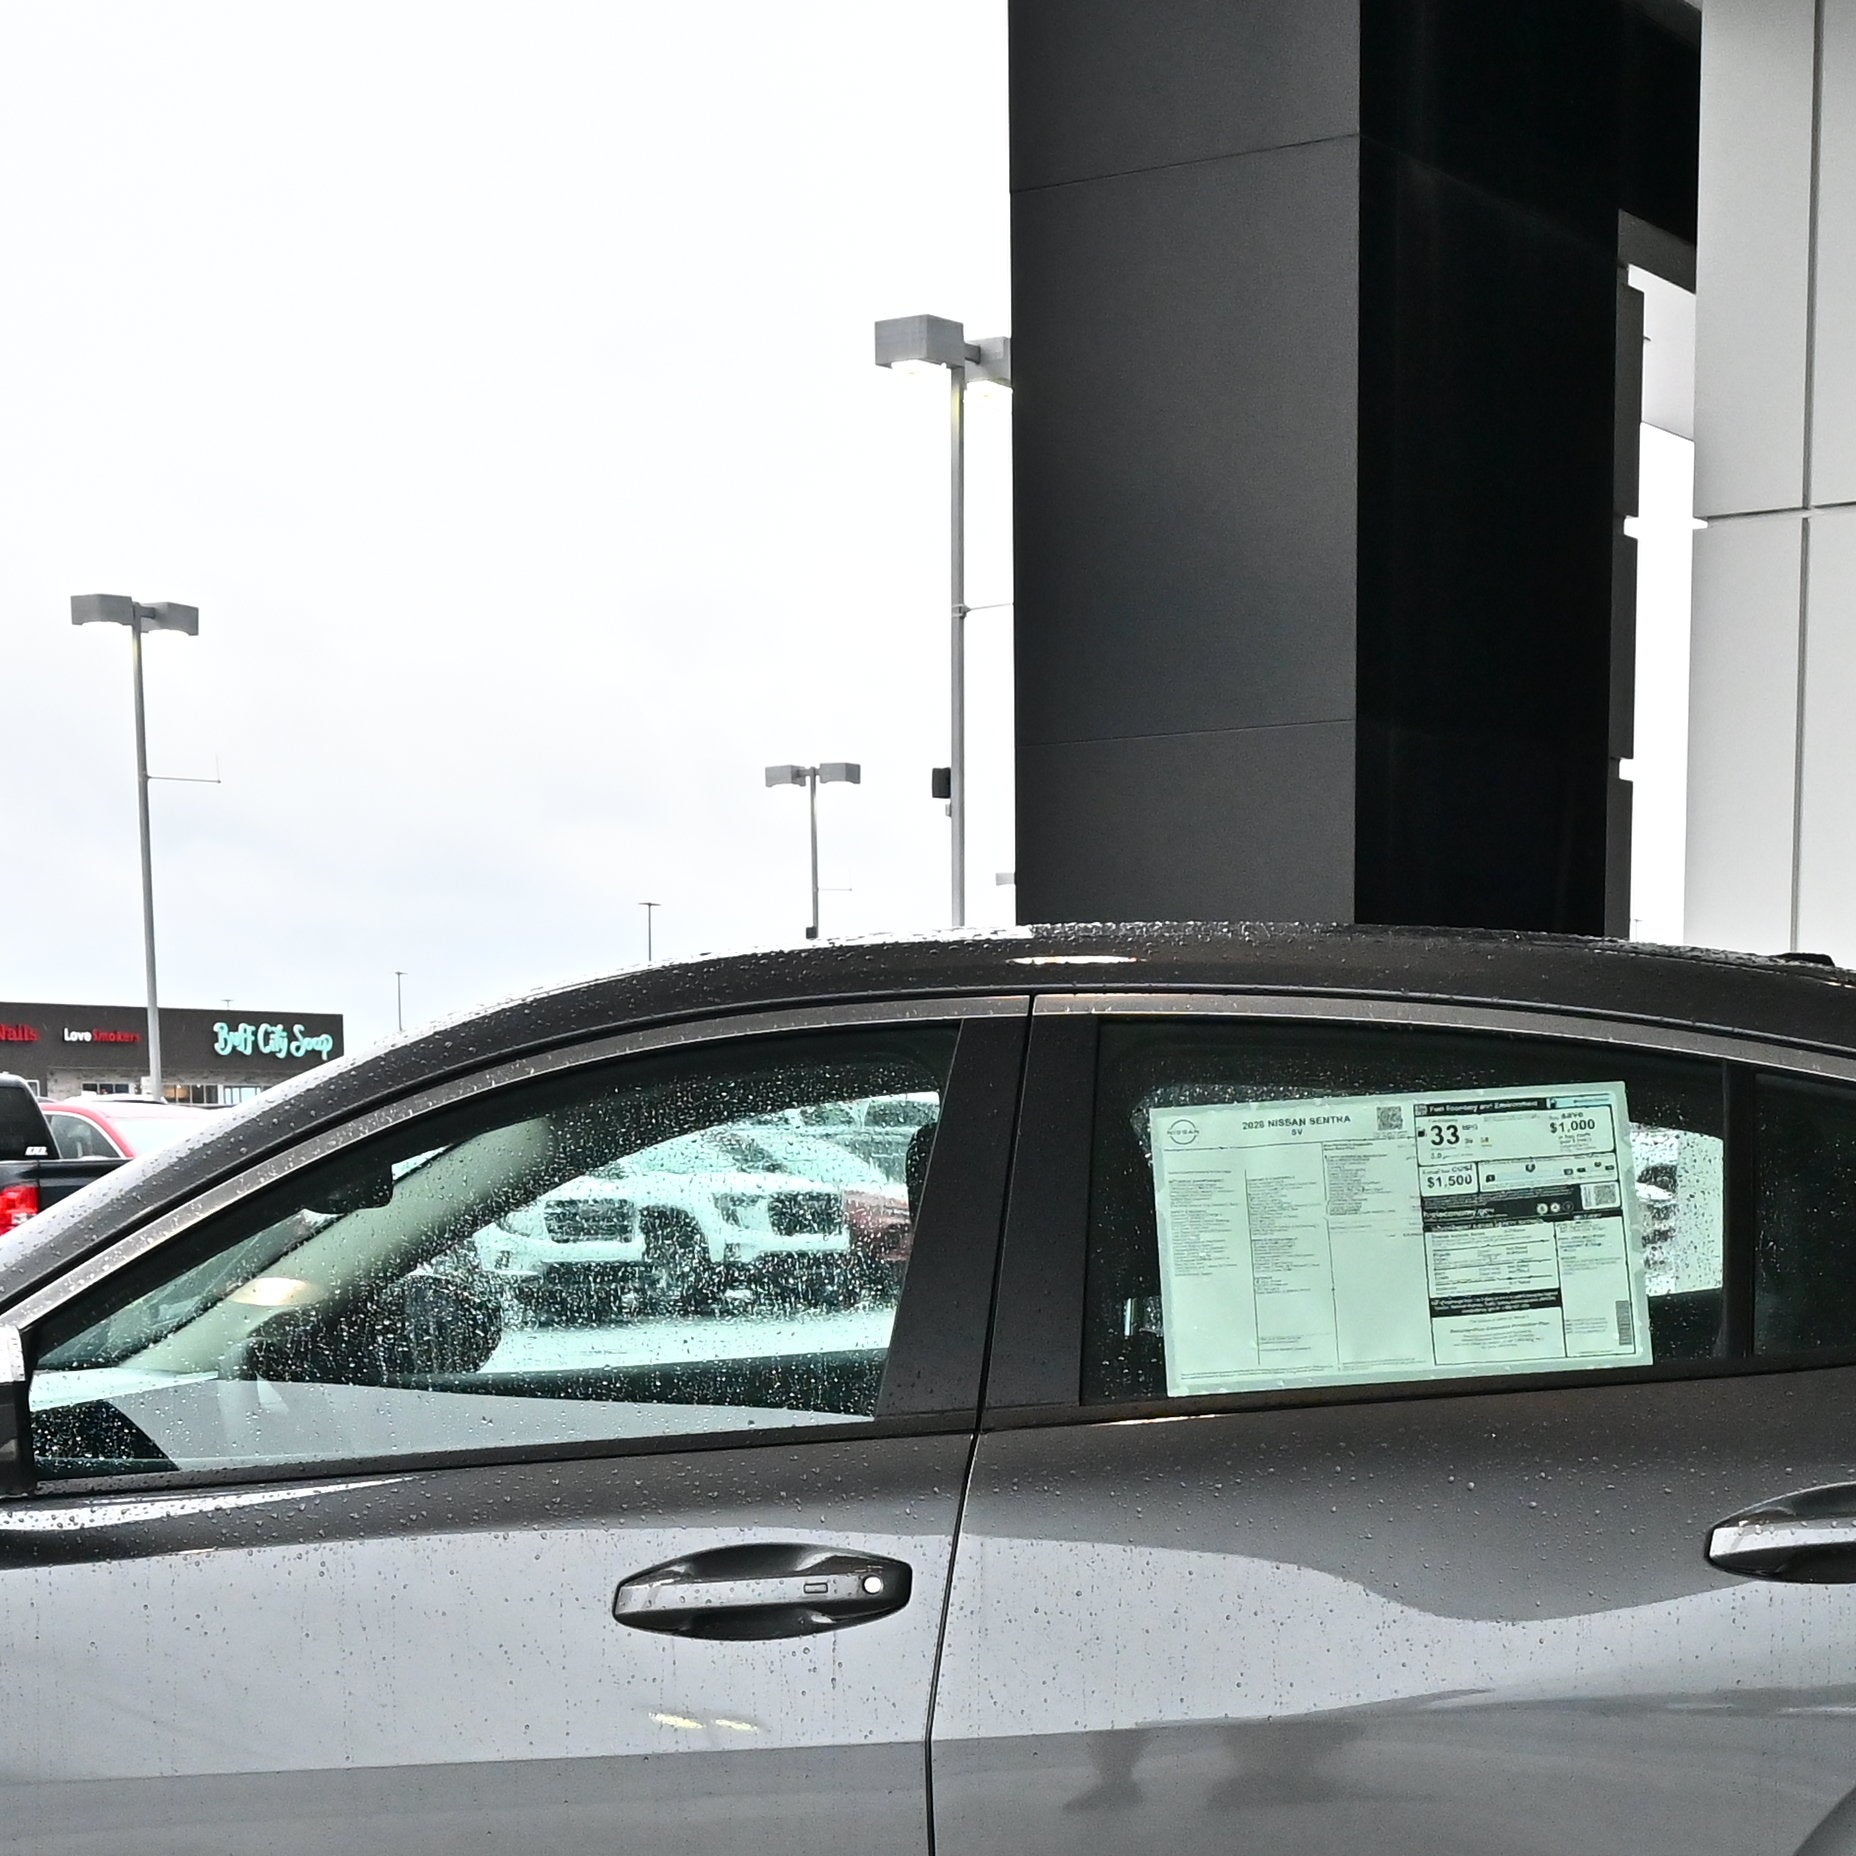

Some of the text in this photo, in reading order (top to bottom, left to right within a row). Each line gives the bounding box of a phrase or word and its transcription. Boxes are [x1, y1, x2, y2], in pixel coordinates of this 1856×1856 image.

[213, 1022, 333, 1060] Buff City Soap
[1268, 1117, 1306, 1128] NISSAN
[1309, 1115, 1351, 1125] SENTRA
[1550, 1118, 1595, 1134] $1,000
[1291, 1128, 1303, 1136] SV
[1430, 1124, 1460, 1146] 33
[1427, 1174, 1473, 1189] $1,500
